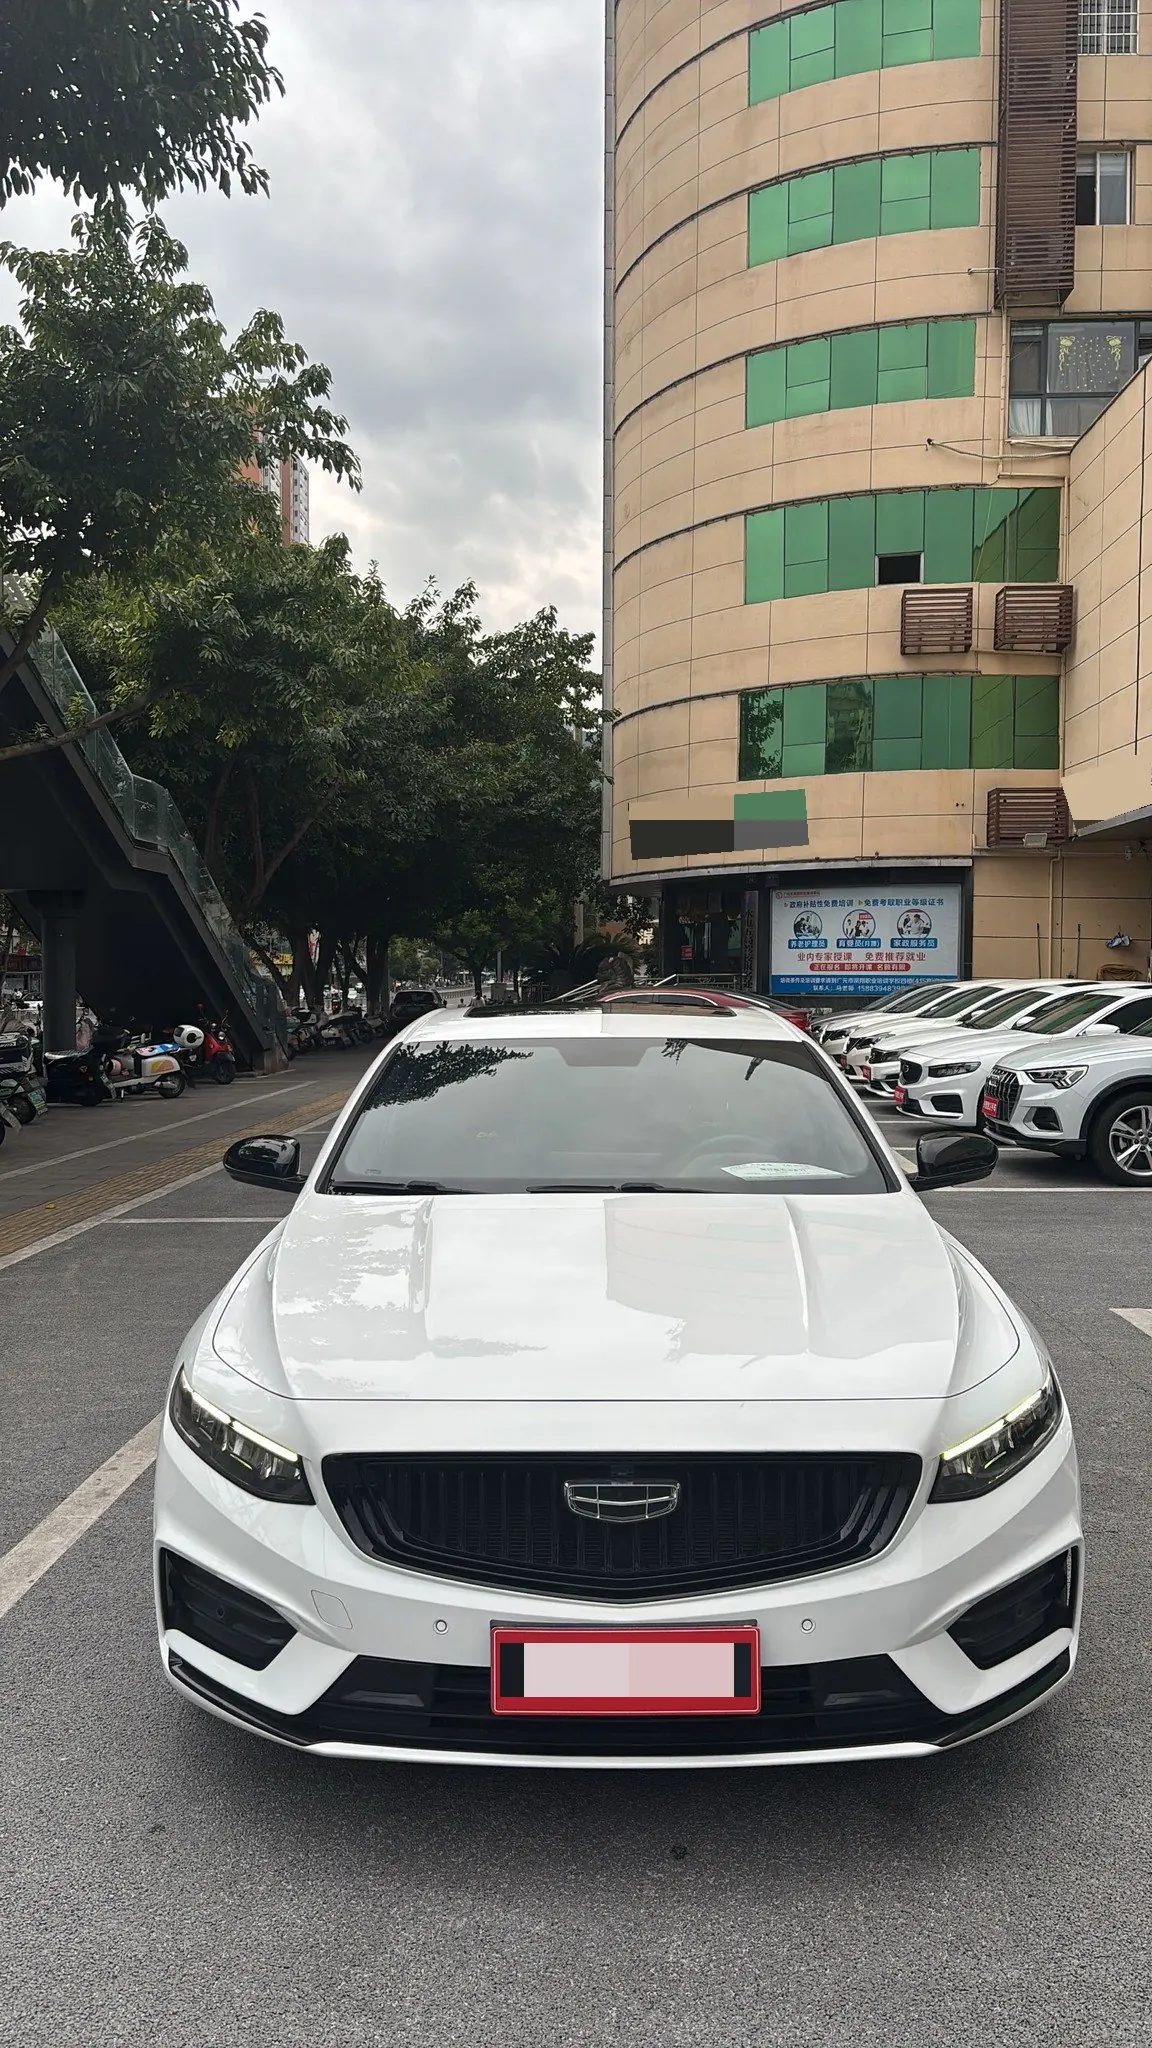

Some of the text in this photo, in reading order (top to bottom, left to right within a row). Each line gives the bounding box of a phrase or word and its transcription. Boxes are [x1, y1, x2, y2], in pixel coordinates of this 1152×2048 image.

[789, 898, 944, 908] 政府补贴性免费培训 免费考取职业等级证书
[790, 939, 826, 948] 养老护理员
[893, 939, 935, 947] 家政服务员
[797, 952, 926, 961] 业内专家授课 免费推荐就业
